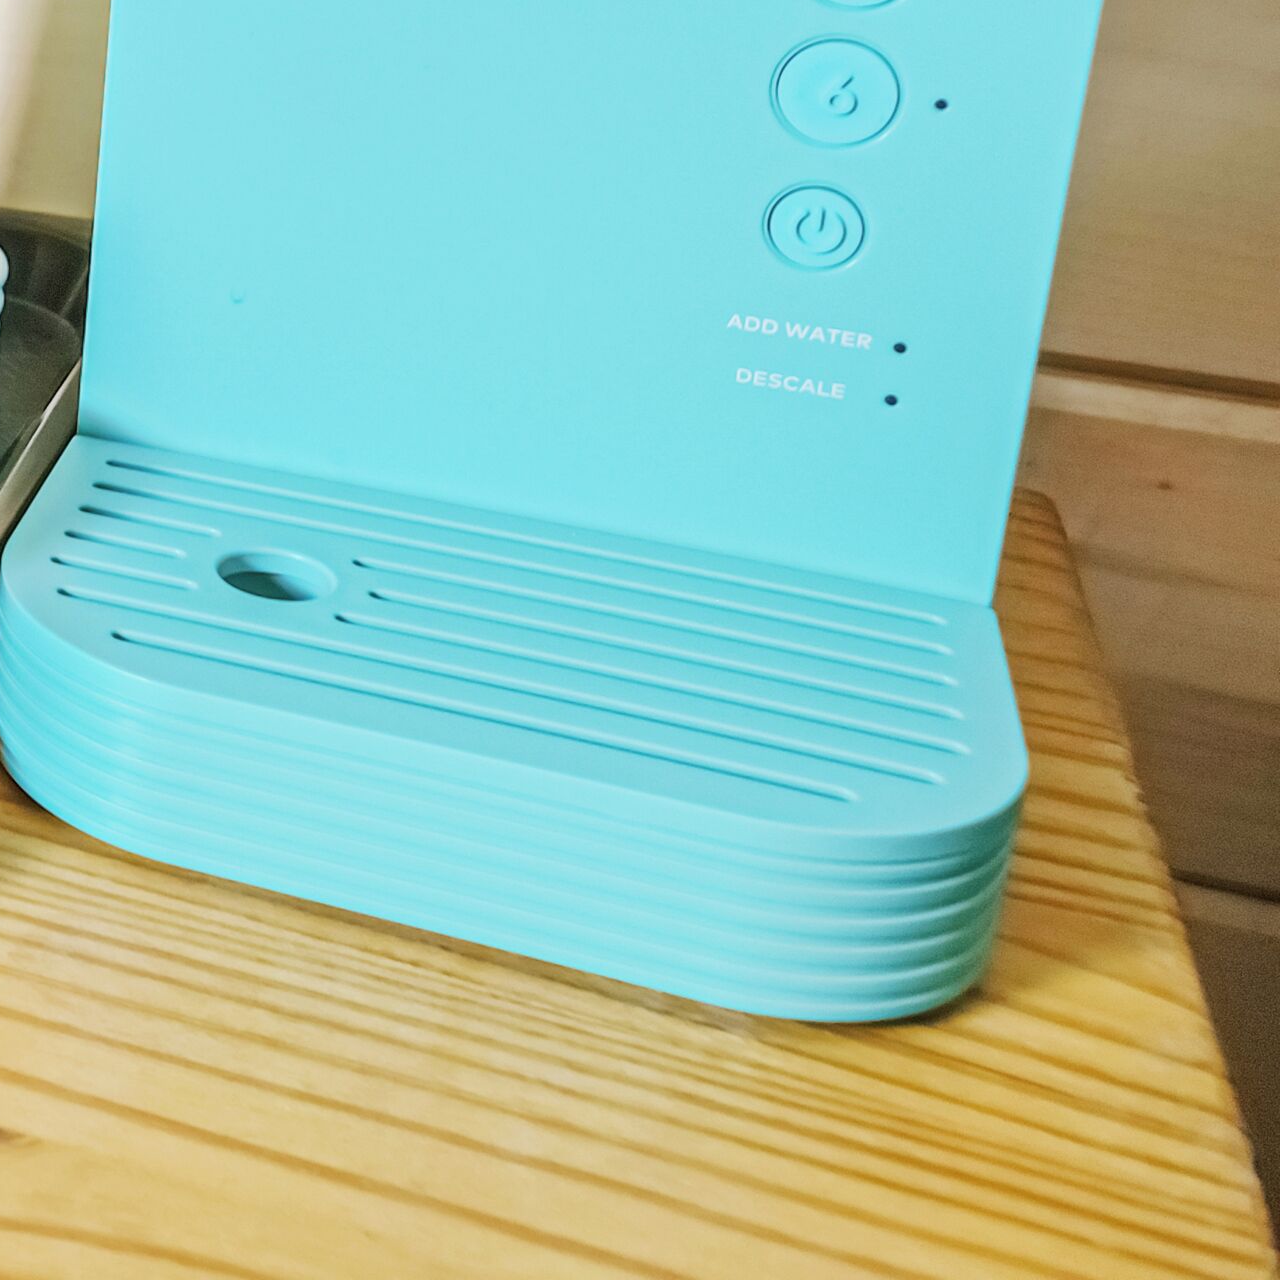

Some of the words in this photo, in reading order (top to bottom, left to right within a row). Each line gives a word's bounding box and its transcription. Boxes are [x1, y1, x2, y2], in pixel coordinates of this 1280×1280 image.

[827, 72, 858, 118] 6
[727, 313, 779, 335] ADD
[785, 321, 873, 350] WATER
[735, 367, 846, 399] DESCALE
